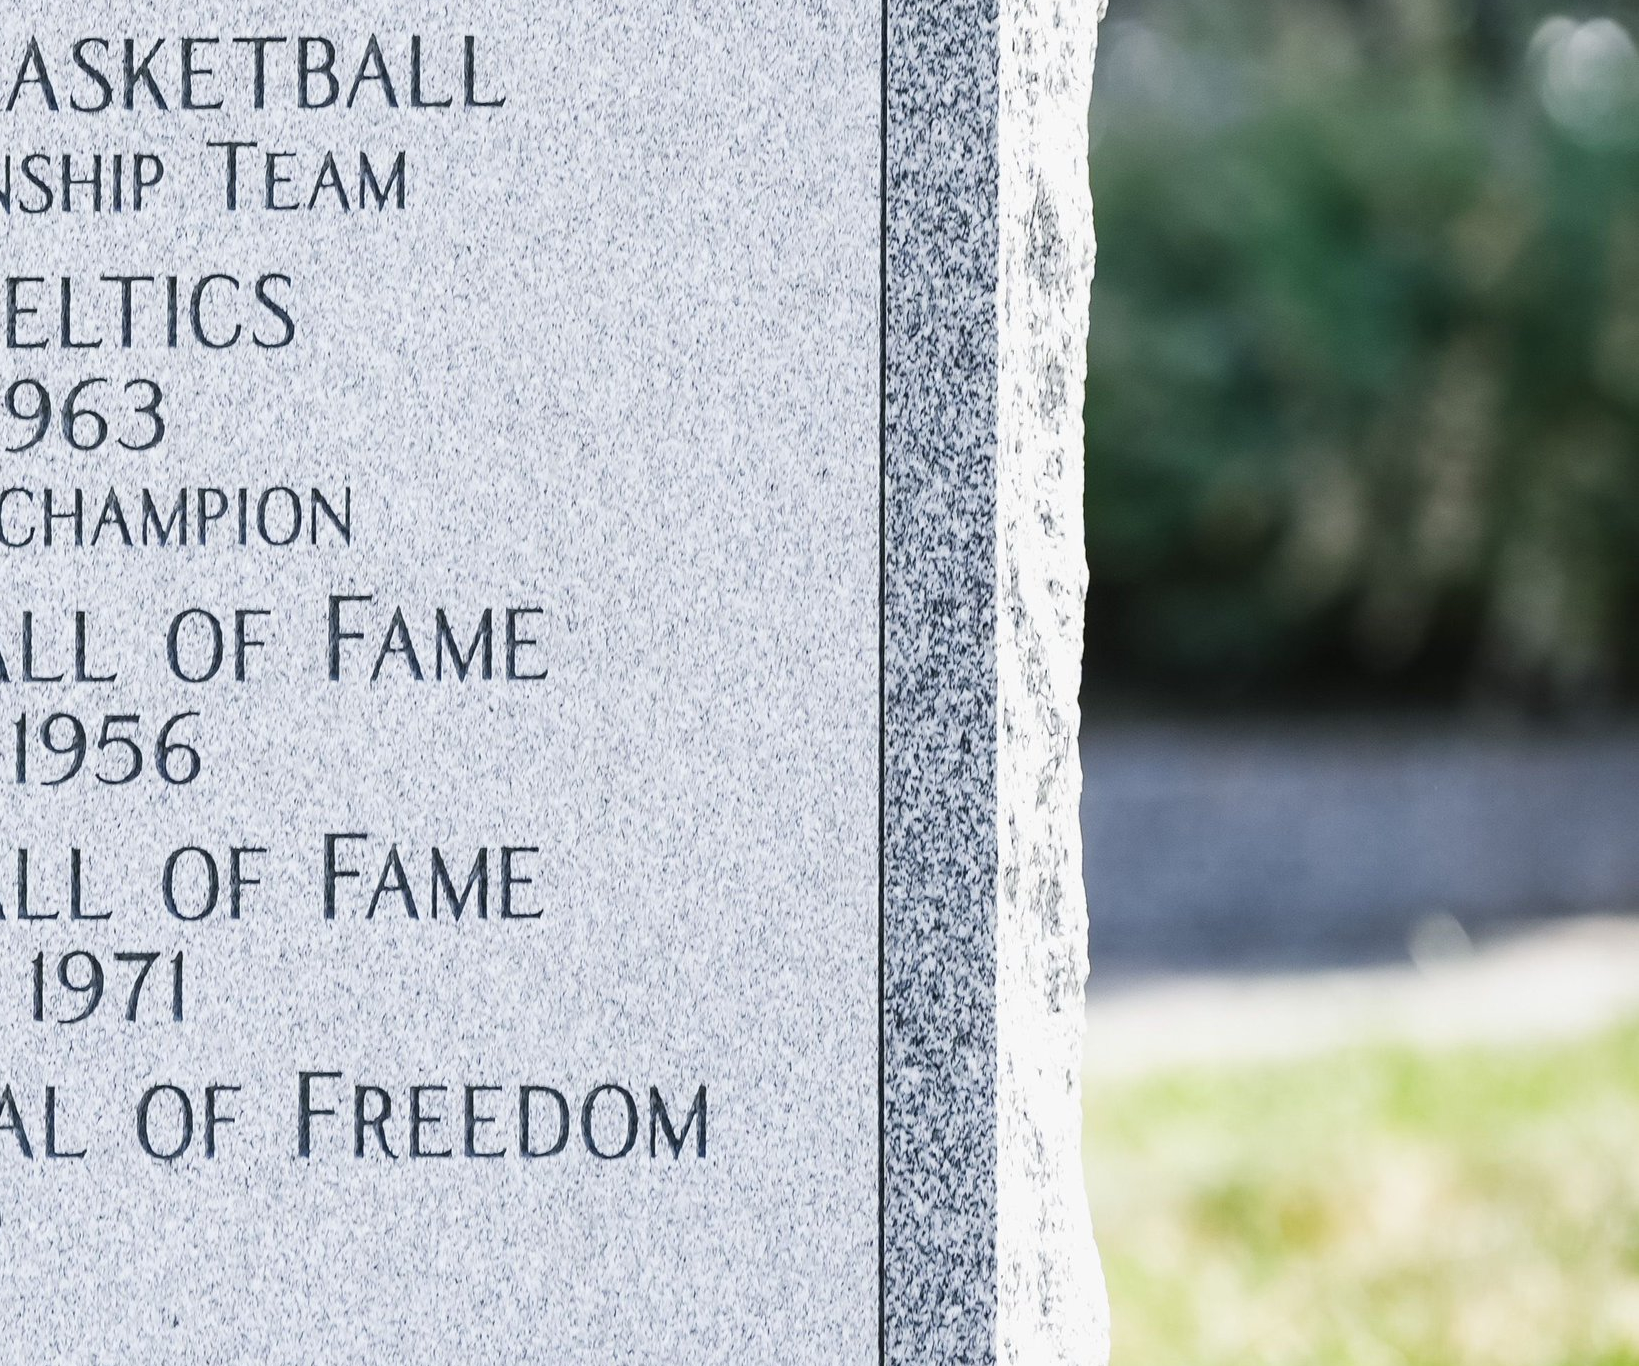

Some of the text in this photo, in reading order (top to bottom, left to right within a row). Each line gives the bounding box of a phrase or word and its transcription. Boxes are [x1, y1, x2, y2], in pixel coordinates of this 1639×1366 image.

[166, 607, 271, 684] OF
[14, 710, 202, 787] 1956
[161, 844, 267, 922] OF
[32, 949, 184, 1025] 1971
[136, 1083, 242, 1164] OF
